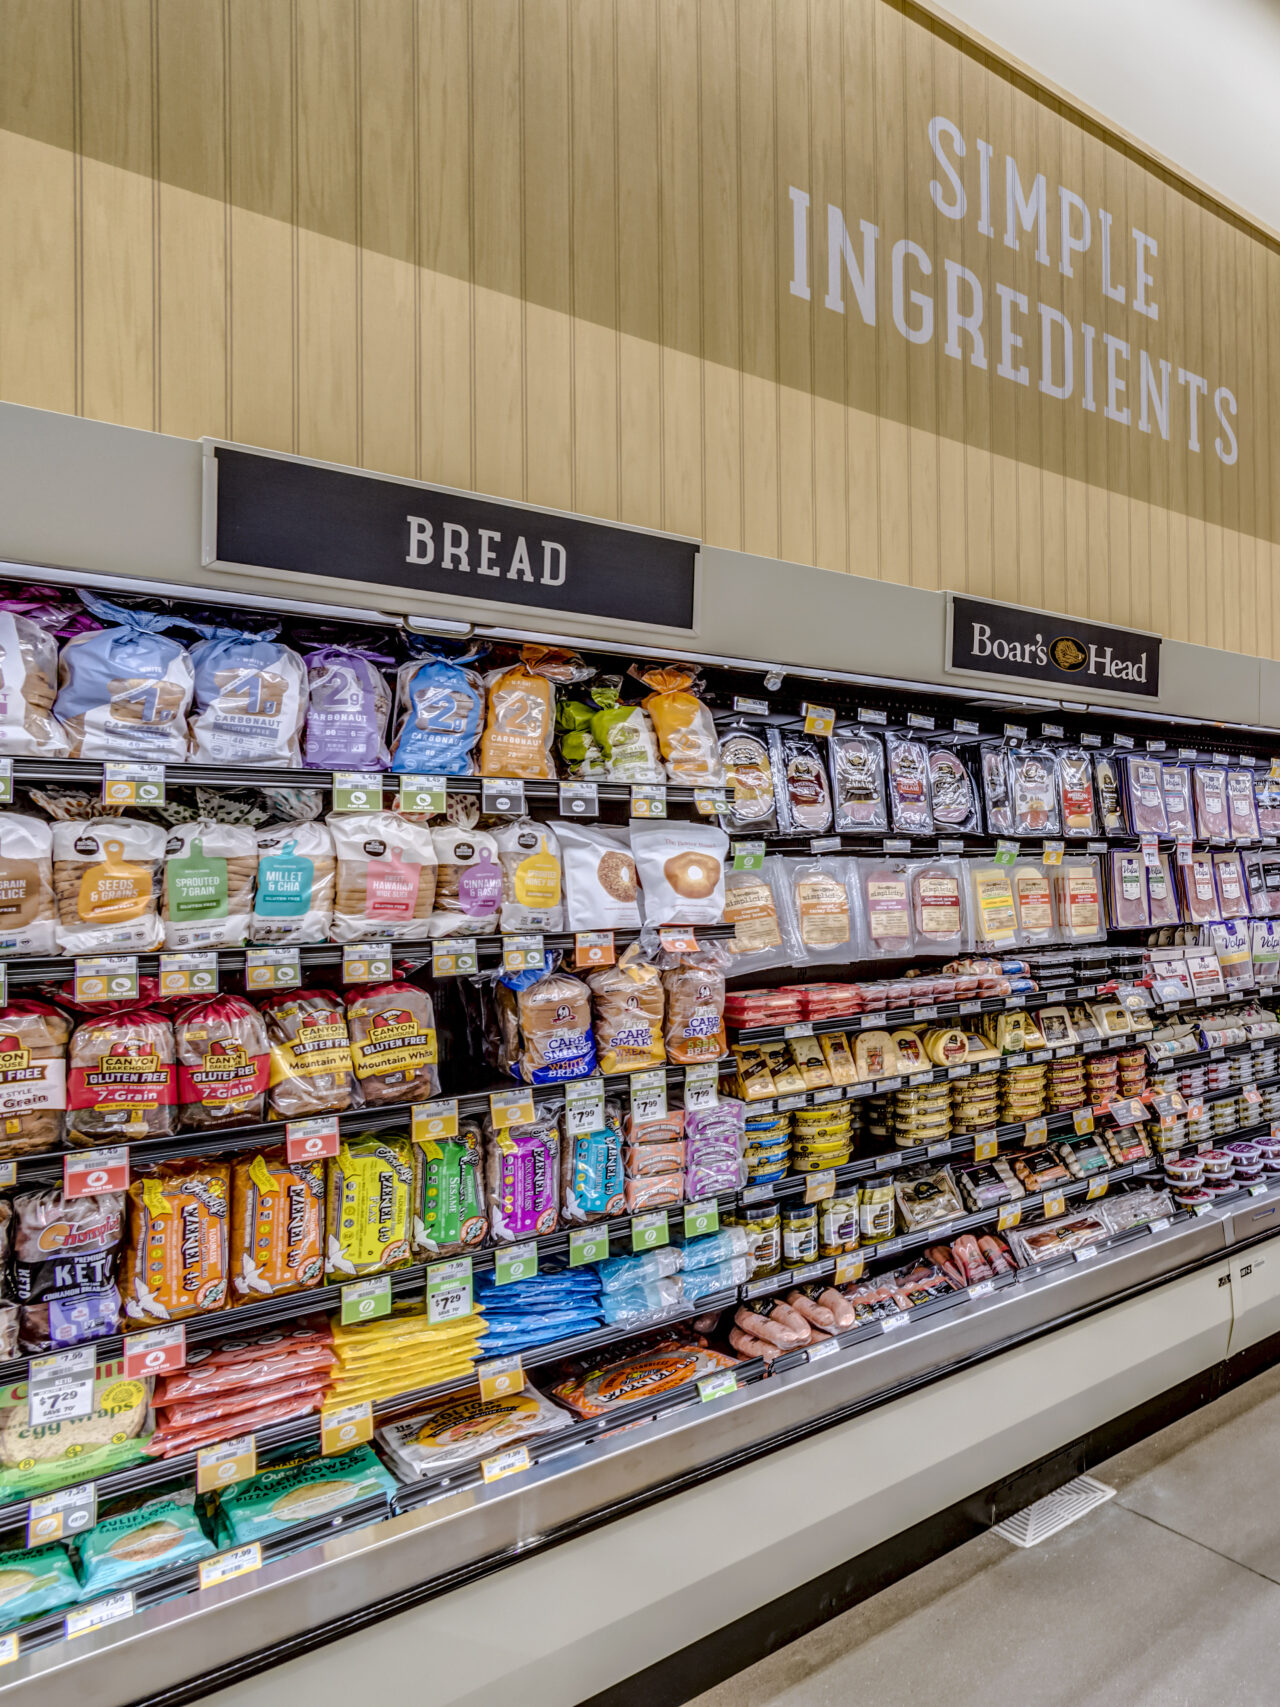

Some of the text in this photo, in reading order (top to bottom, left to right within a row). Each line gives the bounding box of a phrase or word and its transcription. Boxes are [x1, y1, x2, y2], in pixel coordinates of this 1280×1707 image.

[928, 116, 1159, 322] SIMPLE
[789, 185, 1238, 465] INGREDIENTS
[406, 515, 567, 586] BREAD
[970, 622, 1147, 683] Boar's Head
[214, 714, 282, 728] CARBONAUT
[307, 711, 369, 723] CARBONAUT
[411, 732, 465, 747] CARBONAUT
[175, 876, 220, 887] SPROUTED
[266, 871, 303, 882] MILLET
[98, 879, 134, 891] SEEDS
[268, 882, 300, 891] & CHIA
[373, 881, 413, 891] HAWAIIAN
[464, 879, 501, 889] CINNAMO
[91, 889, 139, 902] & GRAINS
[182, 886, 216, 897] 7 GRAIN
[1222, 936, 1248, 950] Volpi
[302, 1024, 346, 1037] CANYON
[372, 1023, 415, 1037] CANYON
[684, 1025, 721, 1038] SMART
[294, 1040, 333, 1054] GLUTEN
[363, 1038, 403, 1055] GLUTEN
[405, 1035, 427, 1046] FREE
[610, 1036, 653, 1048] SMART
[544, 1042, 592, 1061] SMART
[289, 1058, 337, 1070] Mountain
[357, 1048, 434, 1071] Mountain White
[549, 1059, 586, 1071] WHITE
[7, 1068, 42, 1080] FREE
[89, 1072, 168, 1084] GLUTEN FREE
[548, 1065, 589, 1078] BREAD
[98, 1091, 157, 1101] 7-Grain
[604, 1136, 616, 1183] EZEKIEL
[533, 1147, 546, 1196] EZEKIEL
[525, 1157, 534, 1211] CINNAMON RAISIN
[378, 1171, 394, 1224] EZEKIEL
[449, 1177, 460, 1213] SESAME
[287, 1183, 306, 1246] EZEKIEL
[369, 1196, 380, 1224] FLAX
[181, 1203, 199, 1269] EZEKIEL
[74, 1251, 107, 1263] PREMIUM
[55, 1254, 113, 1287] KETO
[18, 1268, 31, 1299] KETO
[43, 1288, 80, 1302] CINNAMON
[597, 1369, 677, 1402] EZEKIEL
[43, 1408, 61, 1417] SAVE
[18, 1422, 61, 1440] egg
[261, 1457, 331, 1483] Outer Aisle
[235, 1492, 270, 1503] PIZZA
[273, 1476, 315, 1493] CRUSTS
[330, 1457, 367, 1474] WRAPS
